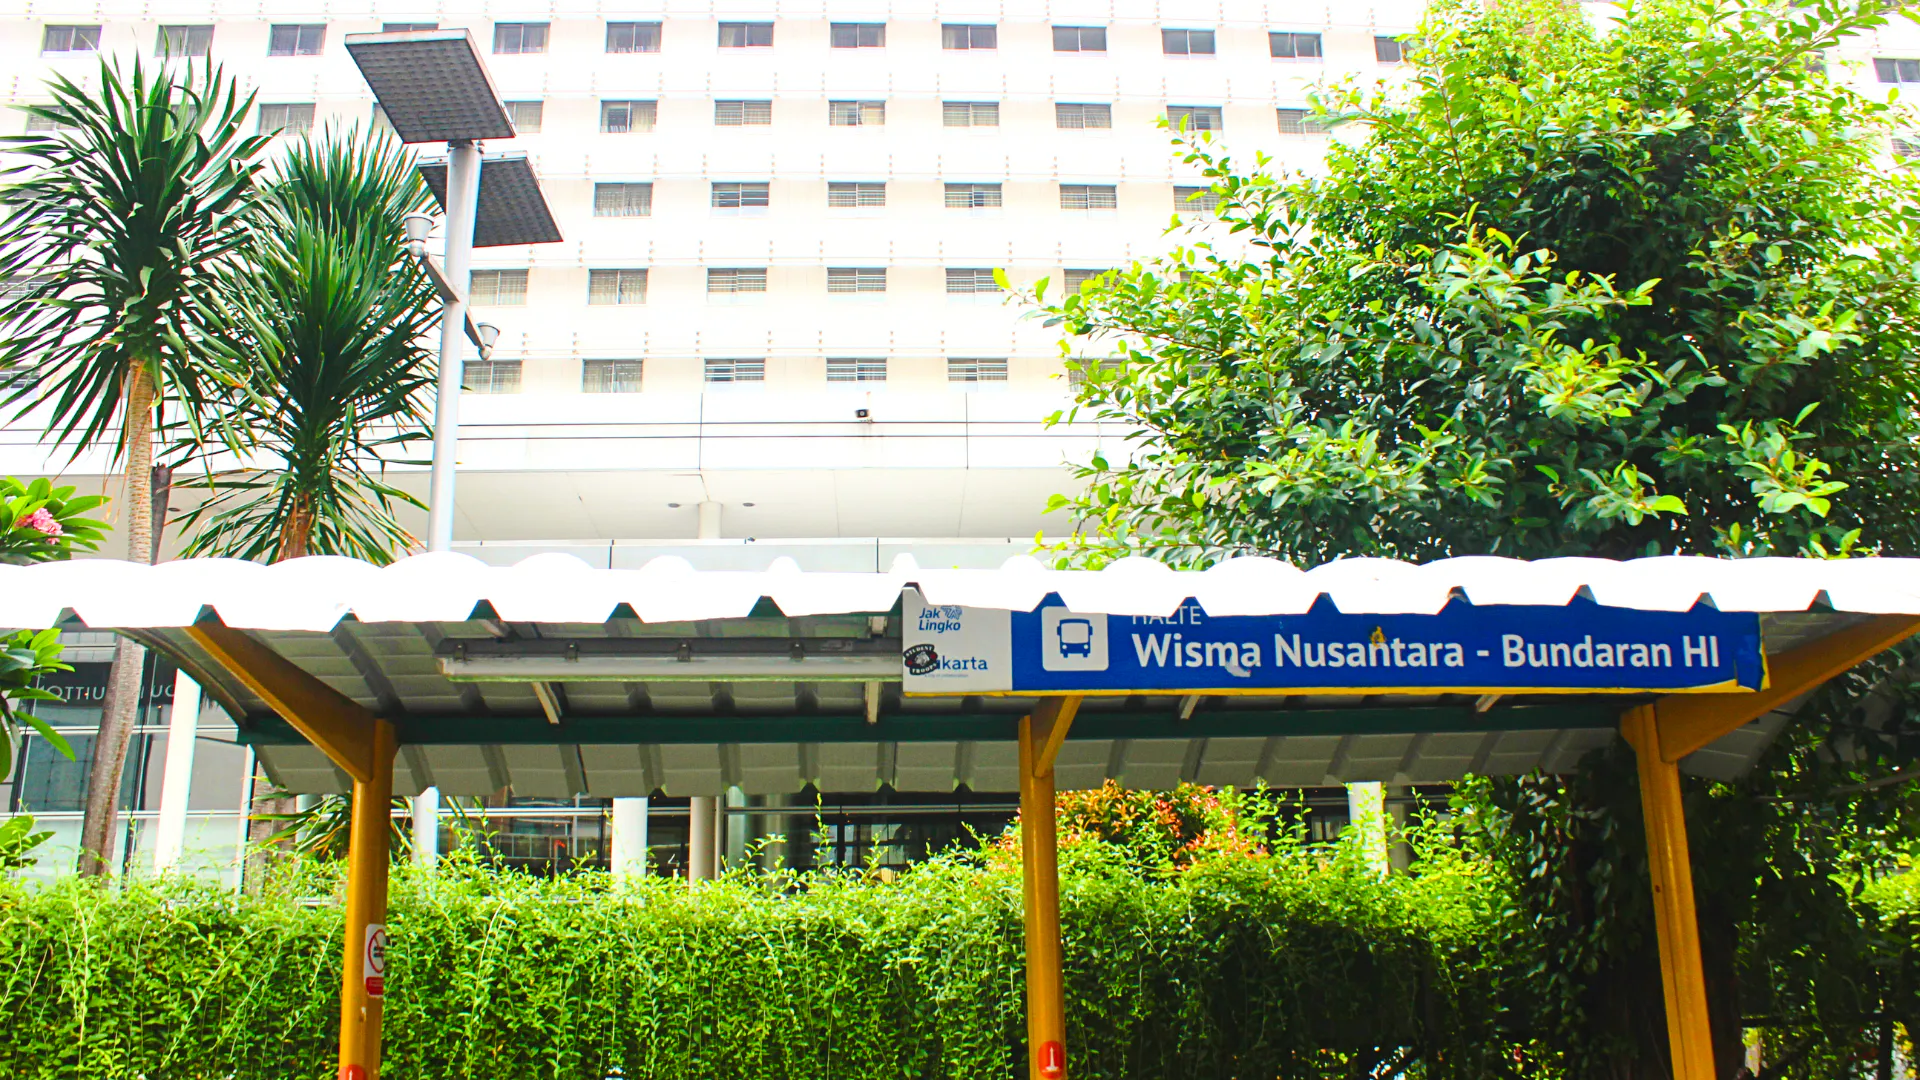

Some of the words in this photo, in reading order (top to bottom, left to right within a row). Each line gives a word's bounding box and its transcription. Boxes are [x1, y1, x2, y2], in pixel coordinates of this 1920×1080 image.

[919, 608, 941, 619] Jak
[919, 620, 961, 633] Lingko
[1131, 633, 1262, 668] Wisma
[1274, 632, 1464, 668] Nusantara
[1502, 634, 1672, 668] Bundaran
[1682, 635, 1719, 668] HI
[936, 655, 988, 670] karta
